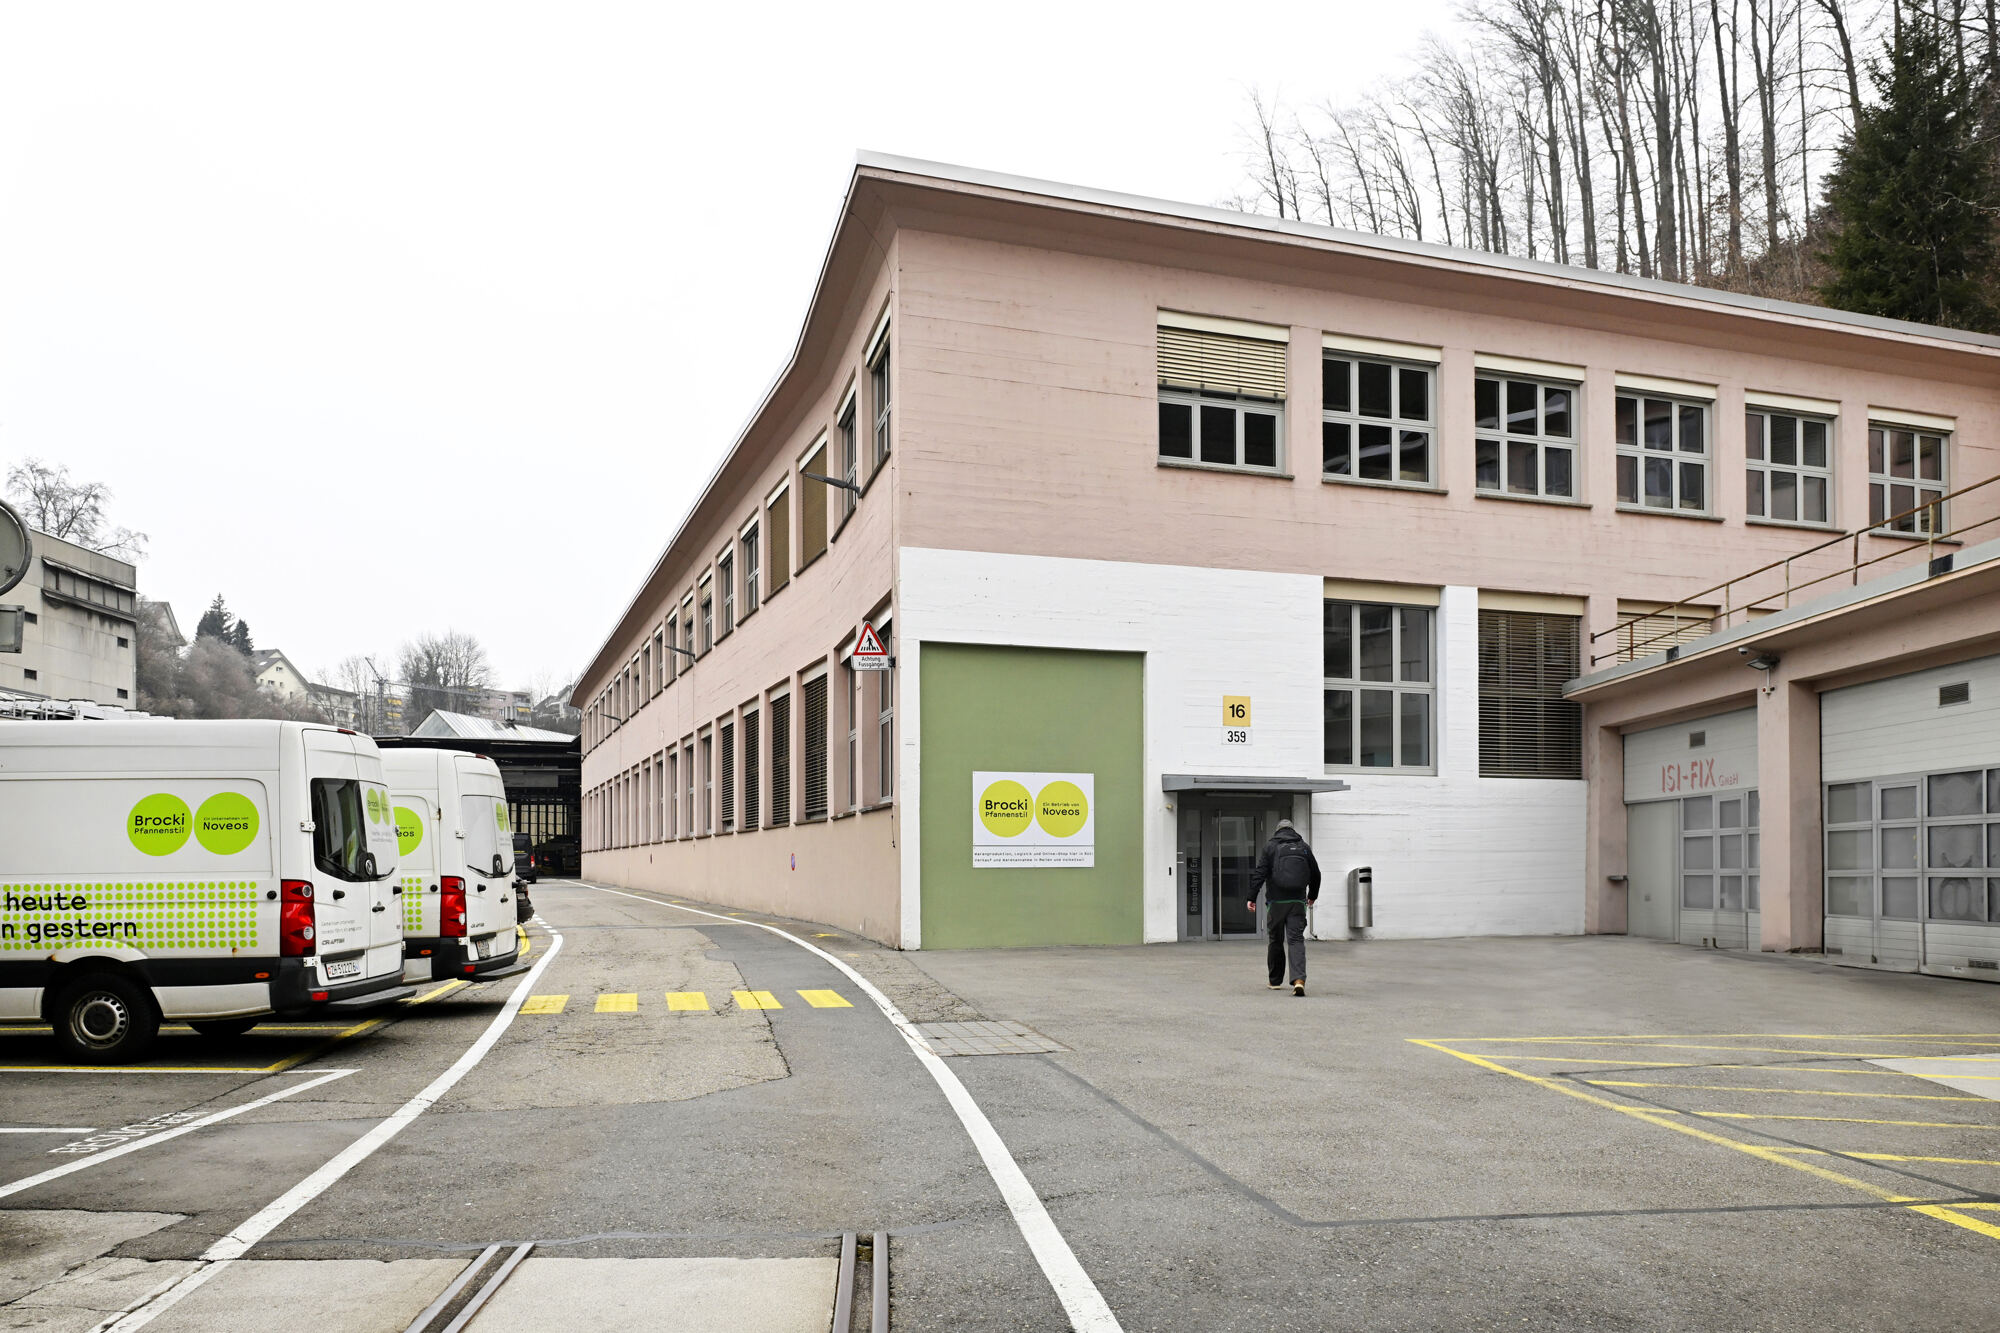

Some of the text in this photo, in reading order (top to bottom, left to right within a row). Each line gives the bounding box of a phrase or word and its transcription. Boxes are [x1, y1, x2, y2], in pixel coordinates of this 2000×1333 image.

[1229, 704, 1245, 718] 16
[1227, 730, 1246, 743] 359
[1661, 757, 1716, 793] ISI-FIX
[985, 799, 1028, 810] Brocki
[1042, 807, 1080, 816] Noveos
[134, 813, 185, 826] Brocki
[203, 821, 249, 831] Noveos
[134, 826, 185, 834] Pfannenstil
[6, 891, 87, 912] heute
[26, 918, 137, 944] gestern
